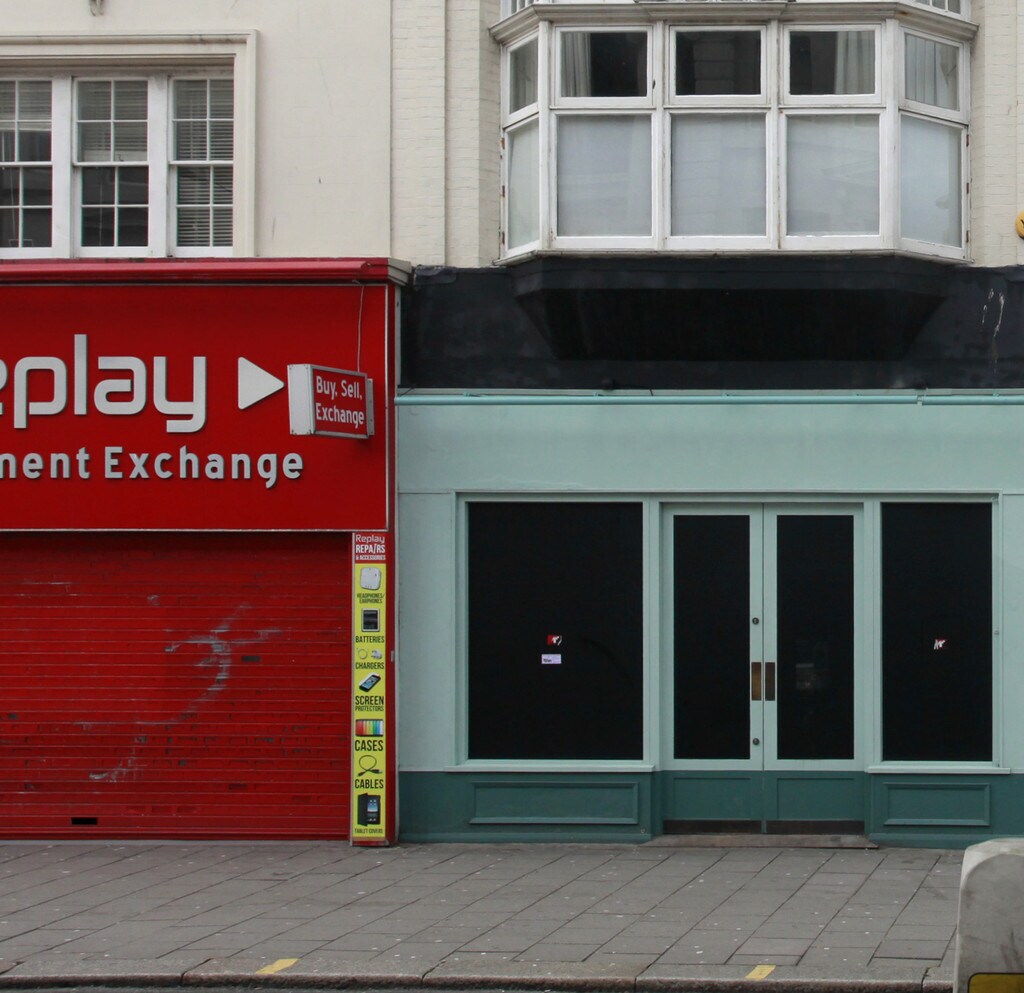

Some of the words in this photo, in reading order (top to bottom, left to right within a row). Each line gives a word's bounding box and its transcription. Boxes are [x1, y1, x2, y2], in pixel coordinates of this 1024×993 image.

[315, 403, 365, 427] Exchange
[104, 445, 304, 489] Exchange
[355, 534, 386, 544] Replay
[355, 635, 385, 644] BATTERIES
[355, 661, 385, 670] CHARGERS
[354, 695, 385, 706] SCREEN
[354, 739, 384, 752] CASES
[354, 778, 384, 789] CABLES
